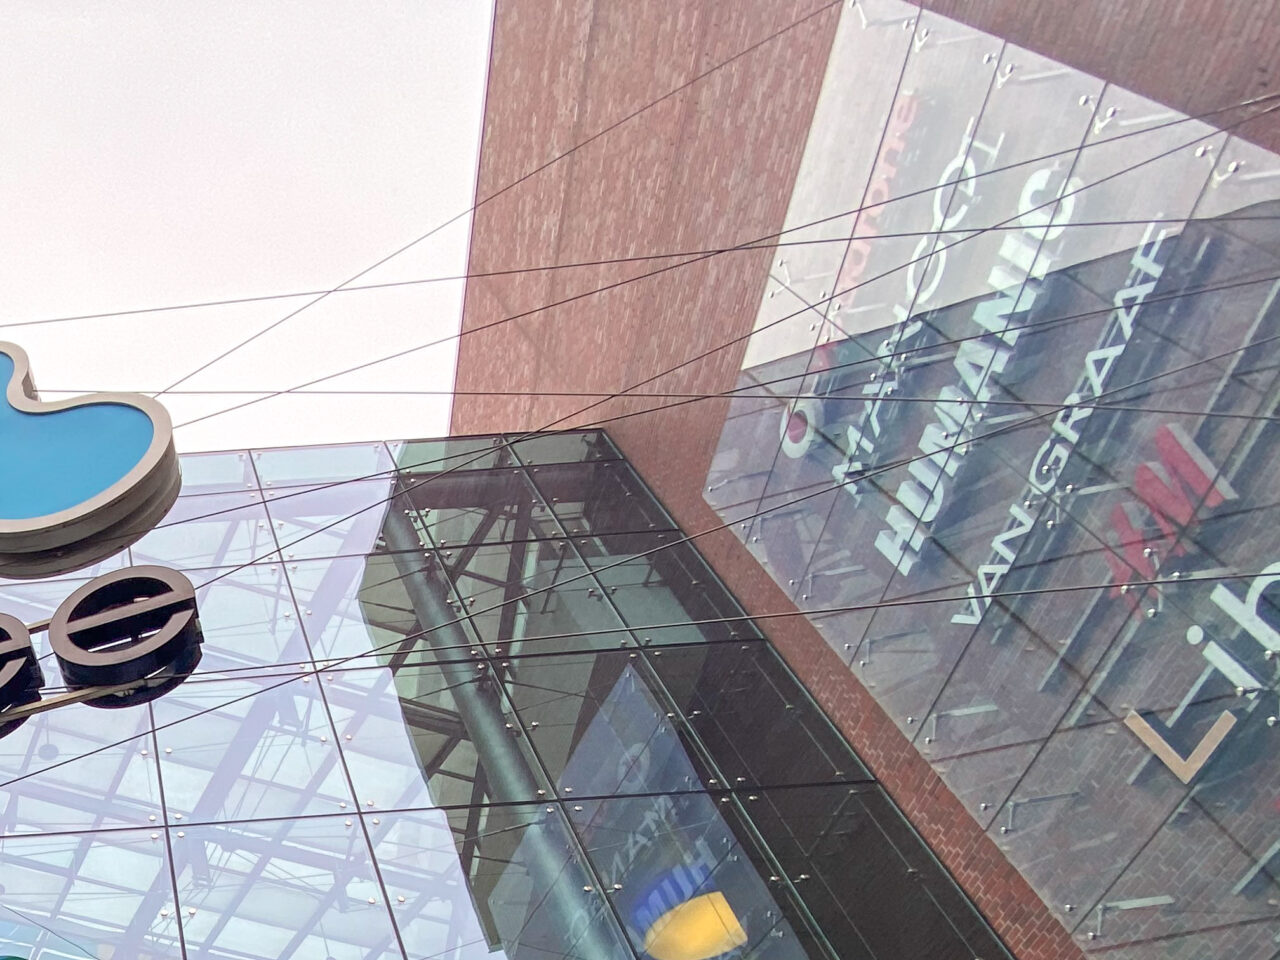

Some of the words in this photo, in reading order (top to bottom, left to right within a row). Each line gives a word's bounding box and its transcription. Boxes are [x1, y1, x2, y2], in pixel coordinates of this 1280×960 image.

[874, 166, 1082, 577] HUMANIC
[951, 503, 1037, 625] VAN
[1028, 213, 1173, 495] GRAAF
